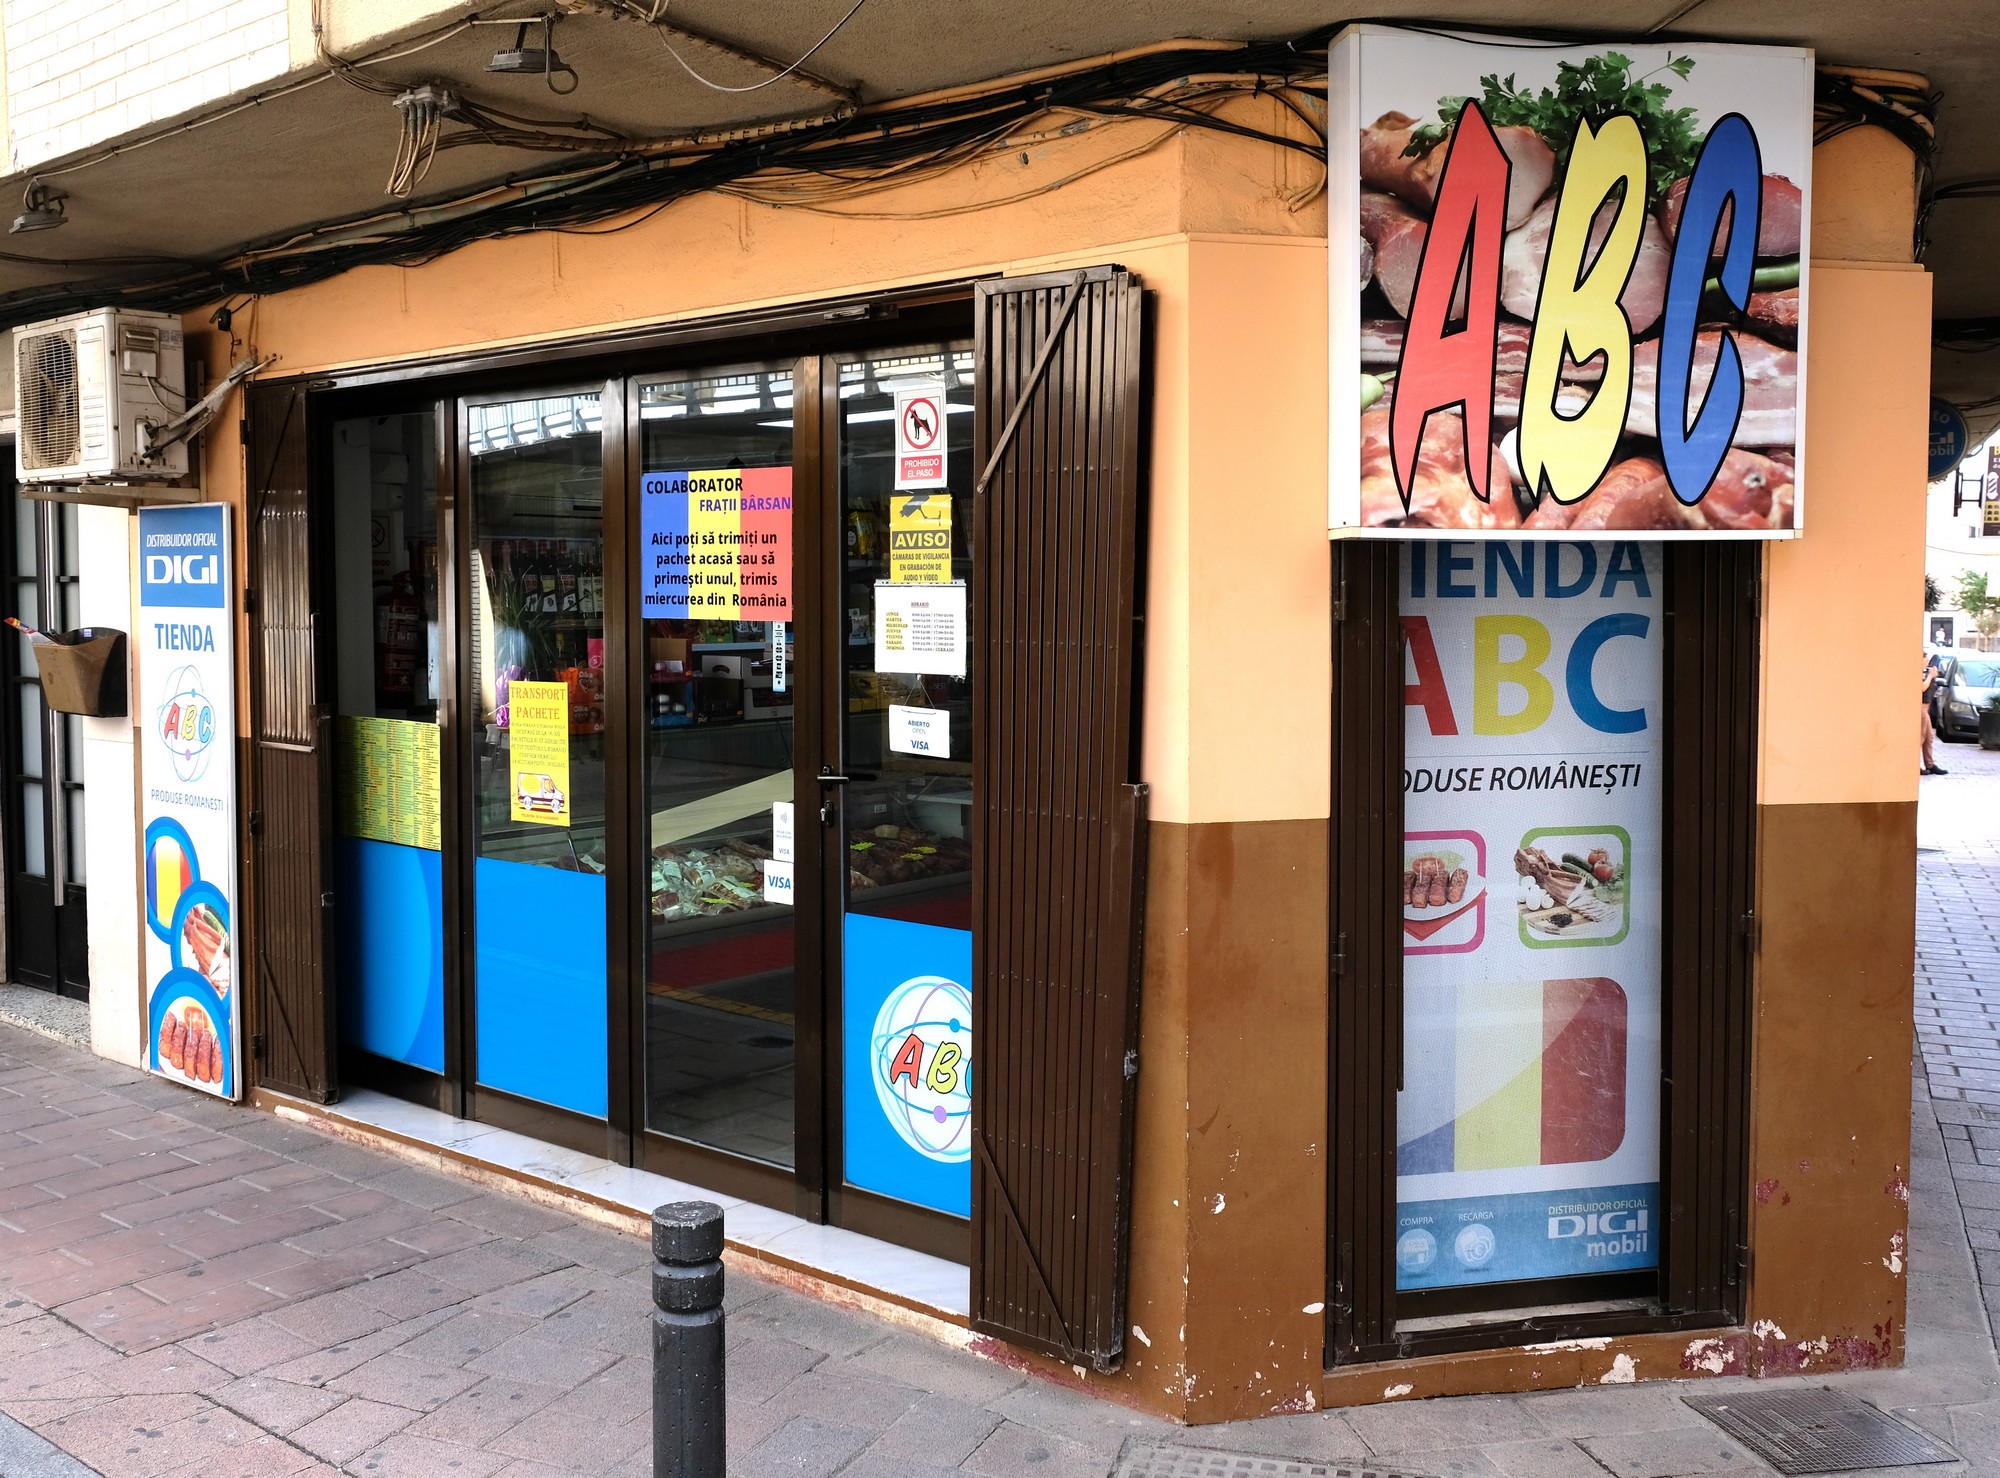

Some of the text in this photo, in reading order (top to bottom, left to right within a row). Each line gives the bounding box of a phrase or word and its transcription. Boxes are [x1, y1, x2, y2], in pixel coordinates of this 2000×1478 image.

[1389, 96, 1762, 515] ABC
[904, 458, 939, 468] PROHIBIDO
[907, 468, 934, 478] EL PASO
[646, 477, 744, 494] COLABORATOR
[699, 495, 791, 514] FRAȚII BÂRSAN
[146, 532, 218, 548] DISTRIBUIDOR OFICIAL
[651, 531, 777, 548] Aici poți să trimiți un
[894, 531, 947, 547] AVISO
[656, 551, 775, 568] pachet acasă sau să
[922, 552, 950, 560] VIGILANCIA
[146, 554, 219, 585] DIGI
[1400, 541, 1652, 598] IENDA
[706, 572, 737, 587] unul,
[740, 572, 778, 586] trimis
[644, 592, 787, 607] miercurea din România
[154, 623, 215, 652] TIENDA
[1404, 613, 1650, 736] ABC
[510, 687, 566, 701] TRANSPORT
[516, 706, 560, 720] PACHETE
[164, 702, 212, 744] ABC
[908, 719, 930, 728] ABIERTO
[912, 727, 926, 735] OPEN
[910, 739, 929, 750] VISA
[1489, 760, 1641, 795] ROMÂNEȘTI
[151, 789, 183, 805] PRODUSE
[778, 847, 790, 855] VISA
[768, 875, 791, 890] VISA
[890, 1033, 972, 1098] AB
[1548, 1199, 1648, 1215] DISTRIBUIDOR OFICIAL
[1400, 1211, 1494, 1226] COMPRA RECARGA
[1548, 1209, 1648, 1239] DIGI
[1587, 1233, 1648, 1257] mobil
